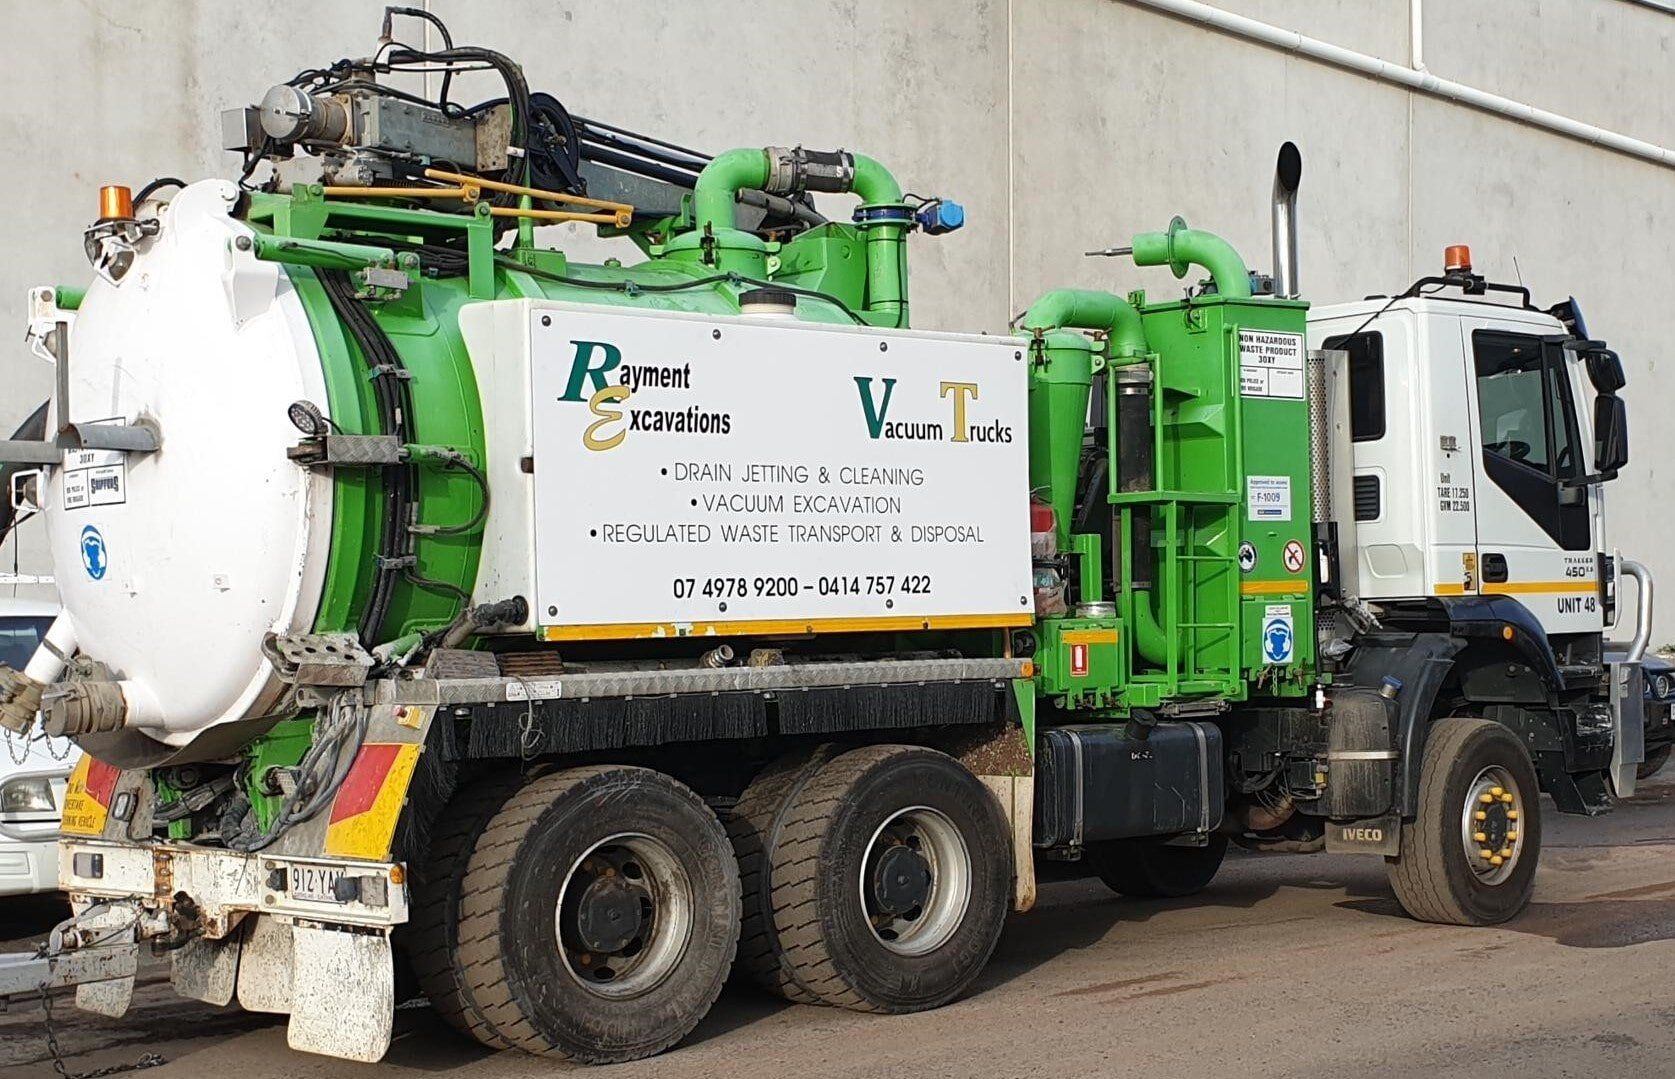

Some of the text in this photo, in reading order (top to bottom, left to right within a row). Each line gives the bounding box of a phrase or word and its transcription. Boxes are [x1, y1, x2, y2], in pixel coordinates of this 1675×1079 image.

[1256, 335, 1297, 346] HAZARDOUS
[1240, 345, 1297, 356] WASTE PRODUCT
[557, 340, 691, 404] Rayment
[582, 385, 731, 451] Excavations
[853, 377, 1012, 444] Vacuum Trucks
[674, 463, 925, 486] DRAIN JETTING & CLEANING
[1257, 493, 1281, 503] F-1009
[1437, 487, 1451, 499] TARE
[702, 494, 901, 514] VACUUM EXCAVATION
[602, 524, 984, 544] REGULATED WASTE TRANSPORT & DISPOSAL
[1566, 567, 1586, 577] 450
[673, 578, 697, 599] 07
[702, 578, 748, 599] 4978
[754, 577, 799, 597] 9200
[818, 576, 860, 597] 0414
[865, 576, 897, 596] 757
[901, 575, 932, 595] 422
[1557, 597, 1596, 614] UNIT 48
[1343, 828, 1382, 841] IVECO
